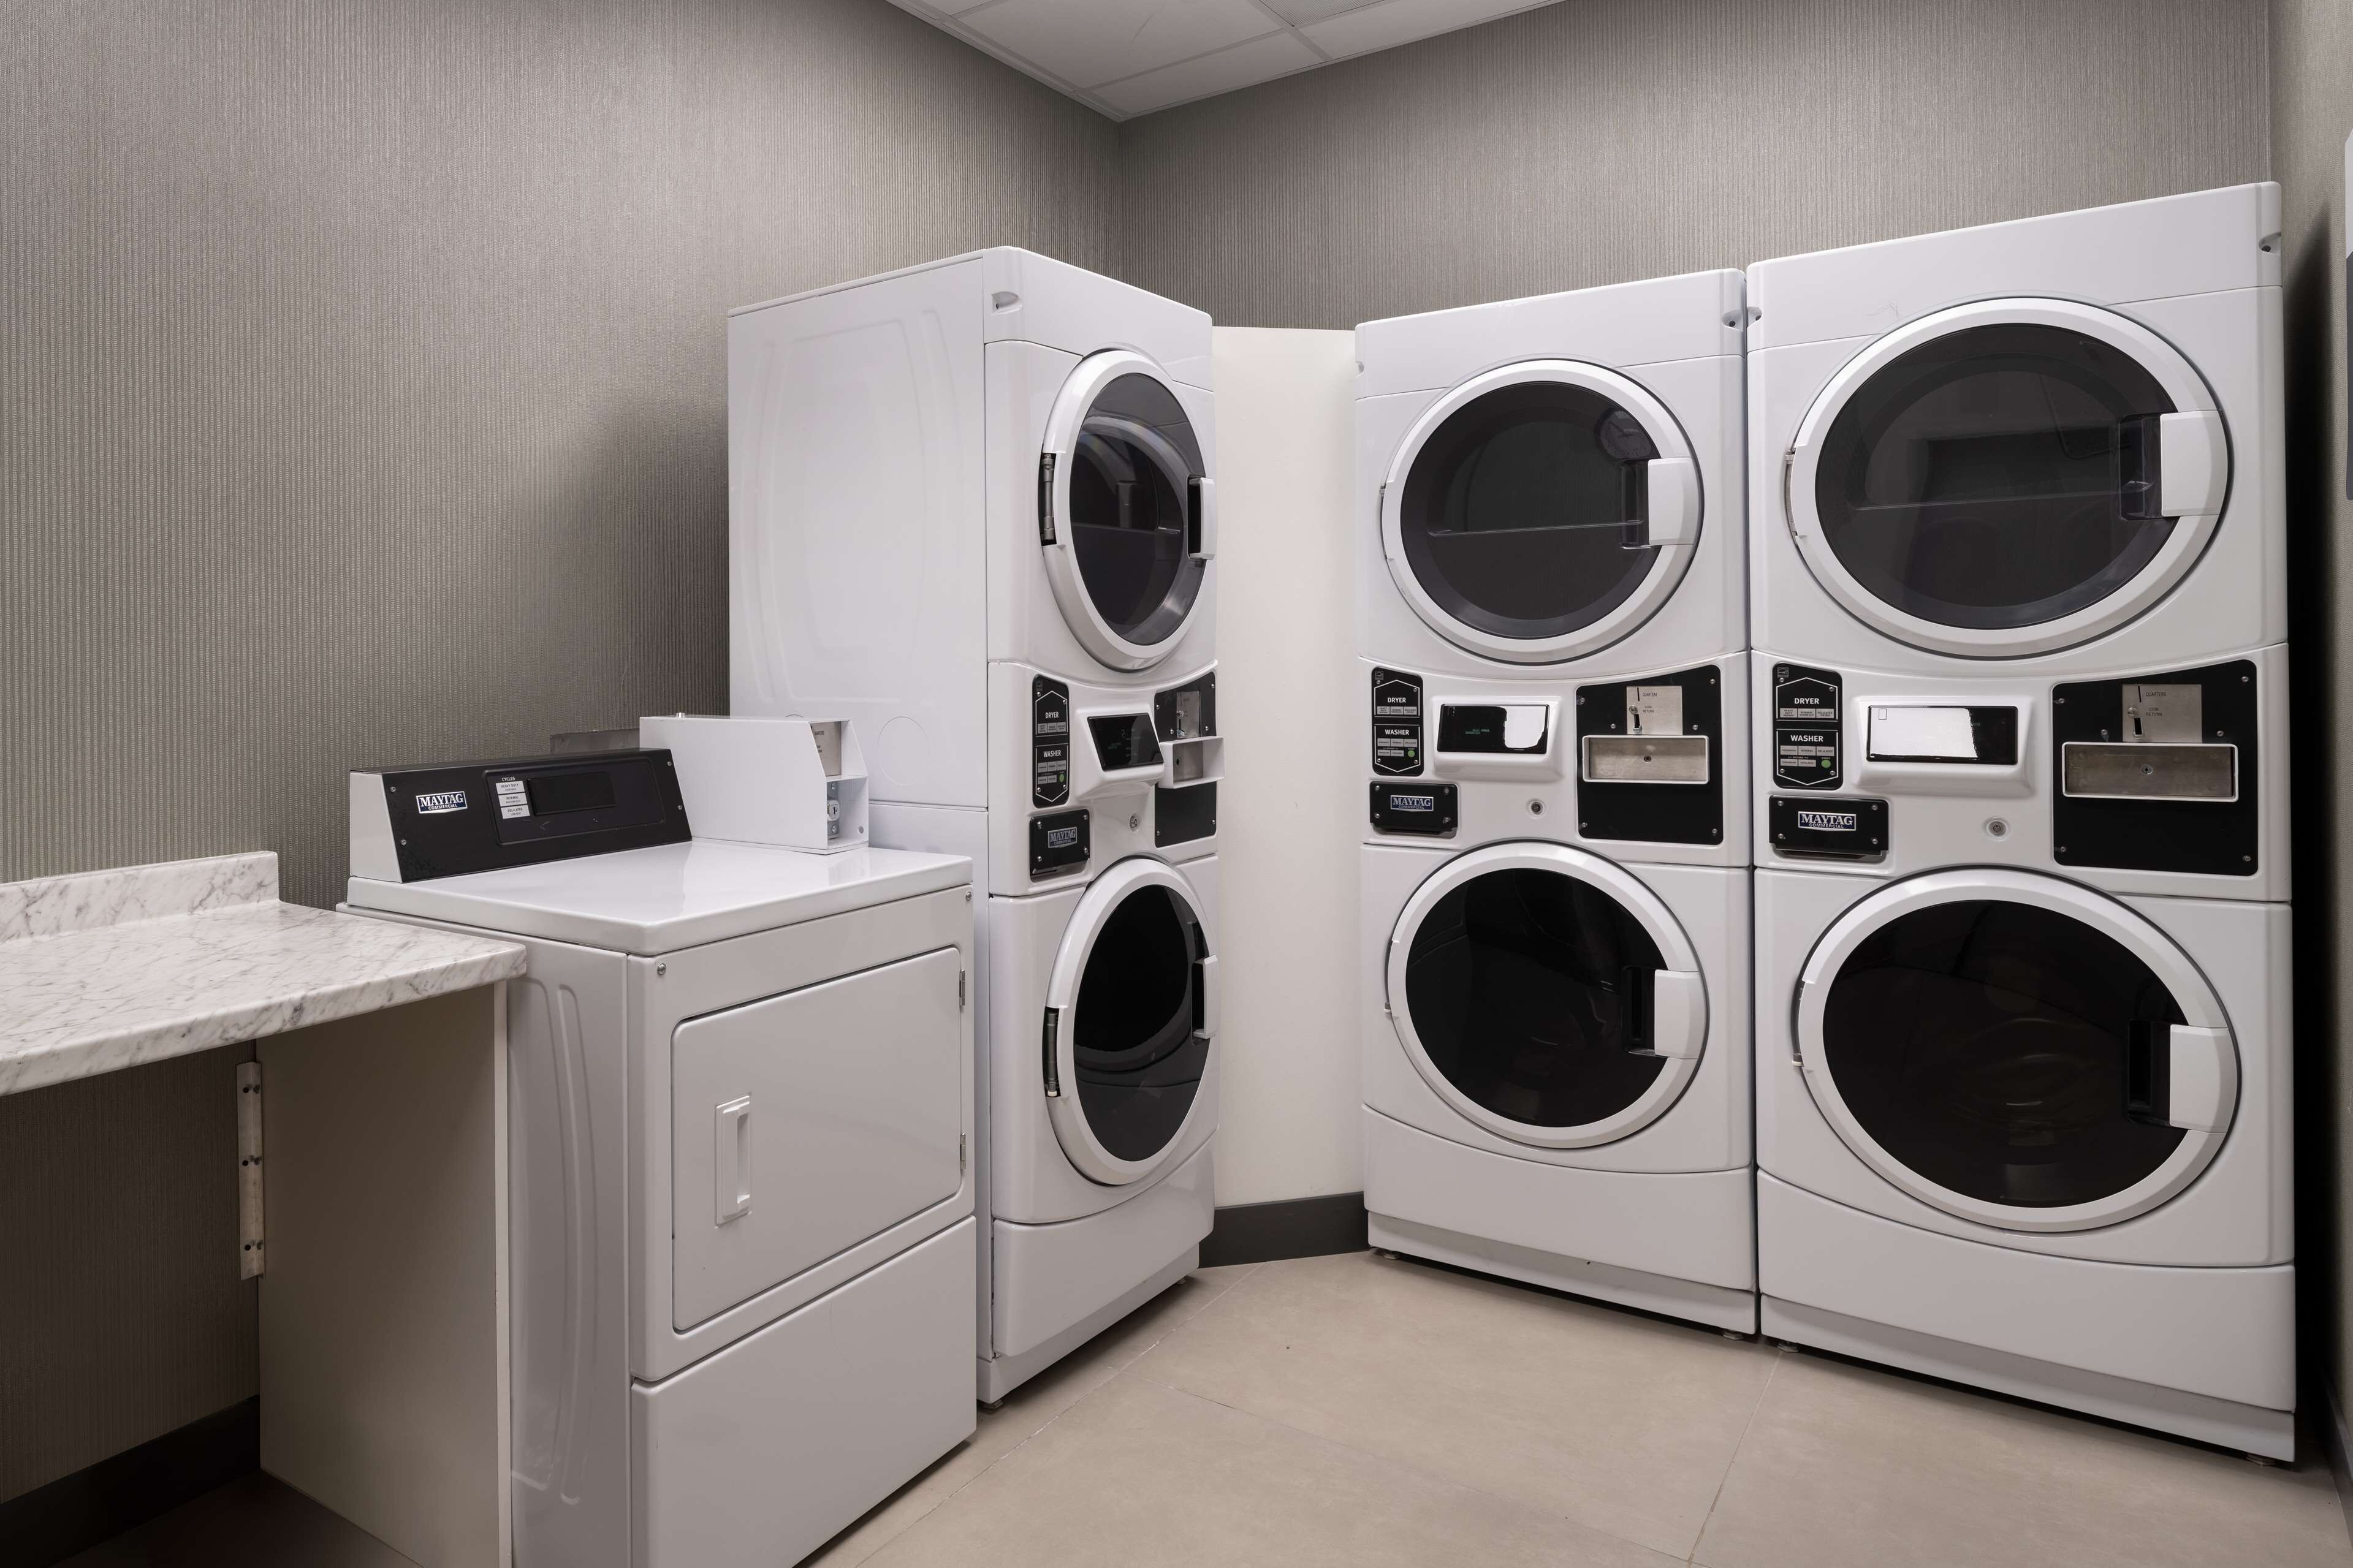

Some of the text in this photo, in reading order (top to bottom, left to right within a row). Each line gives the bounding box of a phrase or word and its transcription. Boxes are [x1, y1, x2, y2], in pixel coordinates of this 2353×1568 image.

[419, 793, 464, 807] MAYTAG
[1393, 797, 1431, 806] MAYTAG
[1801, 814, 1853, 825] MAYTAG
[1050, 829, 1076, 842] MAYTAG
